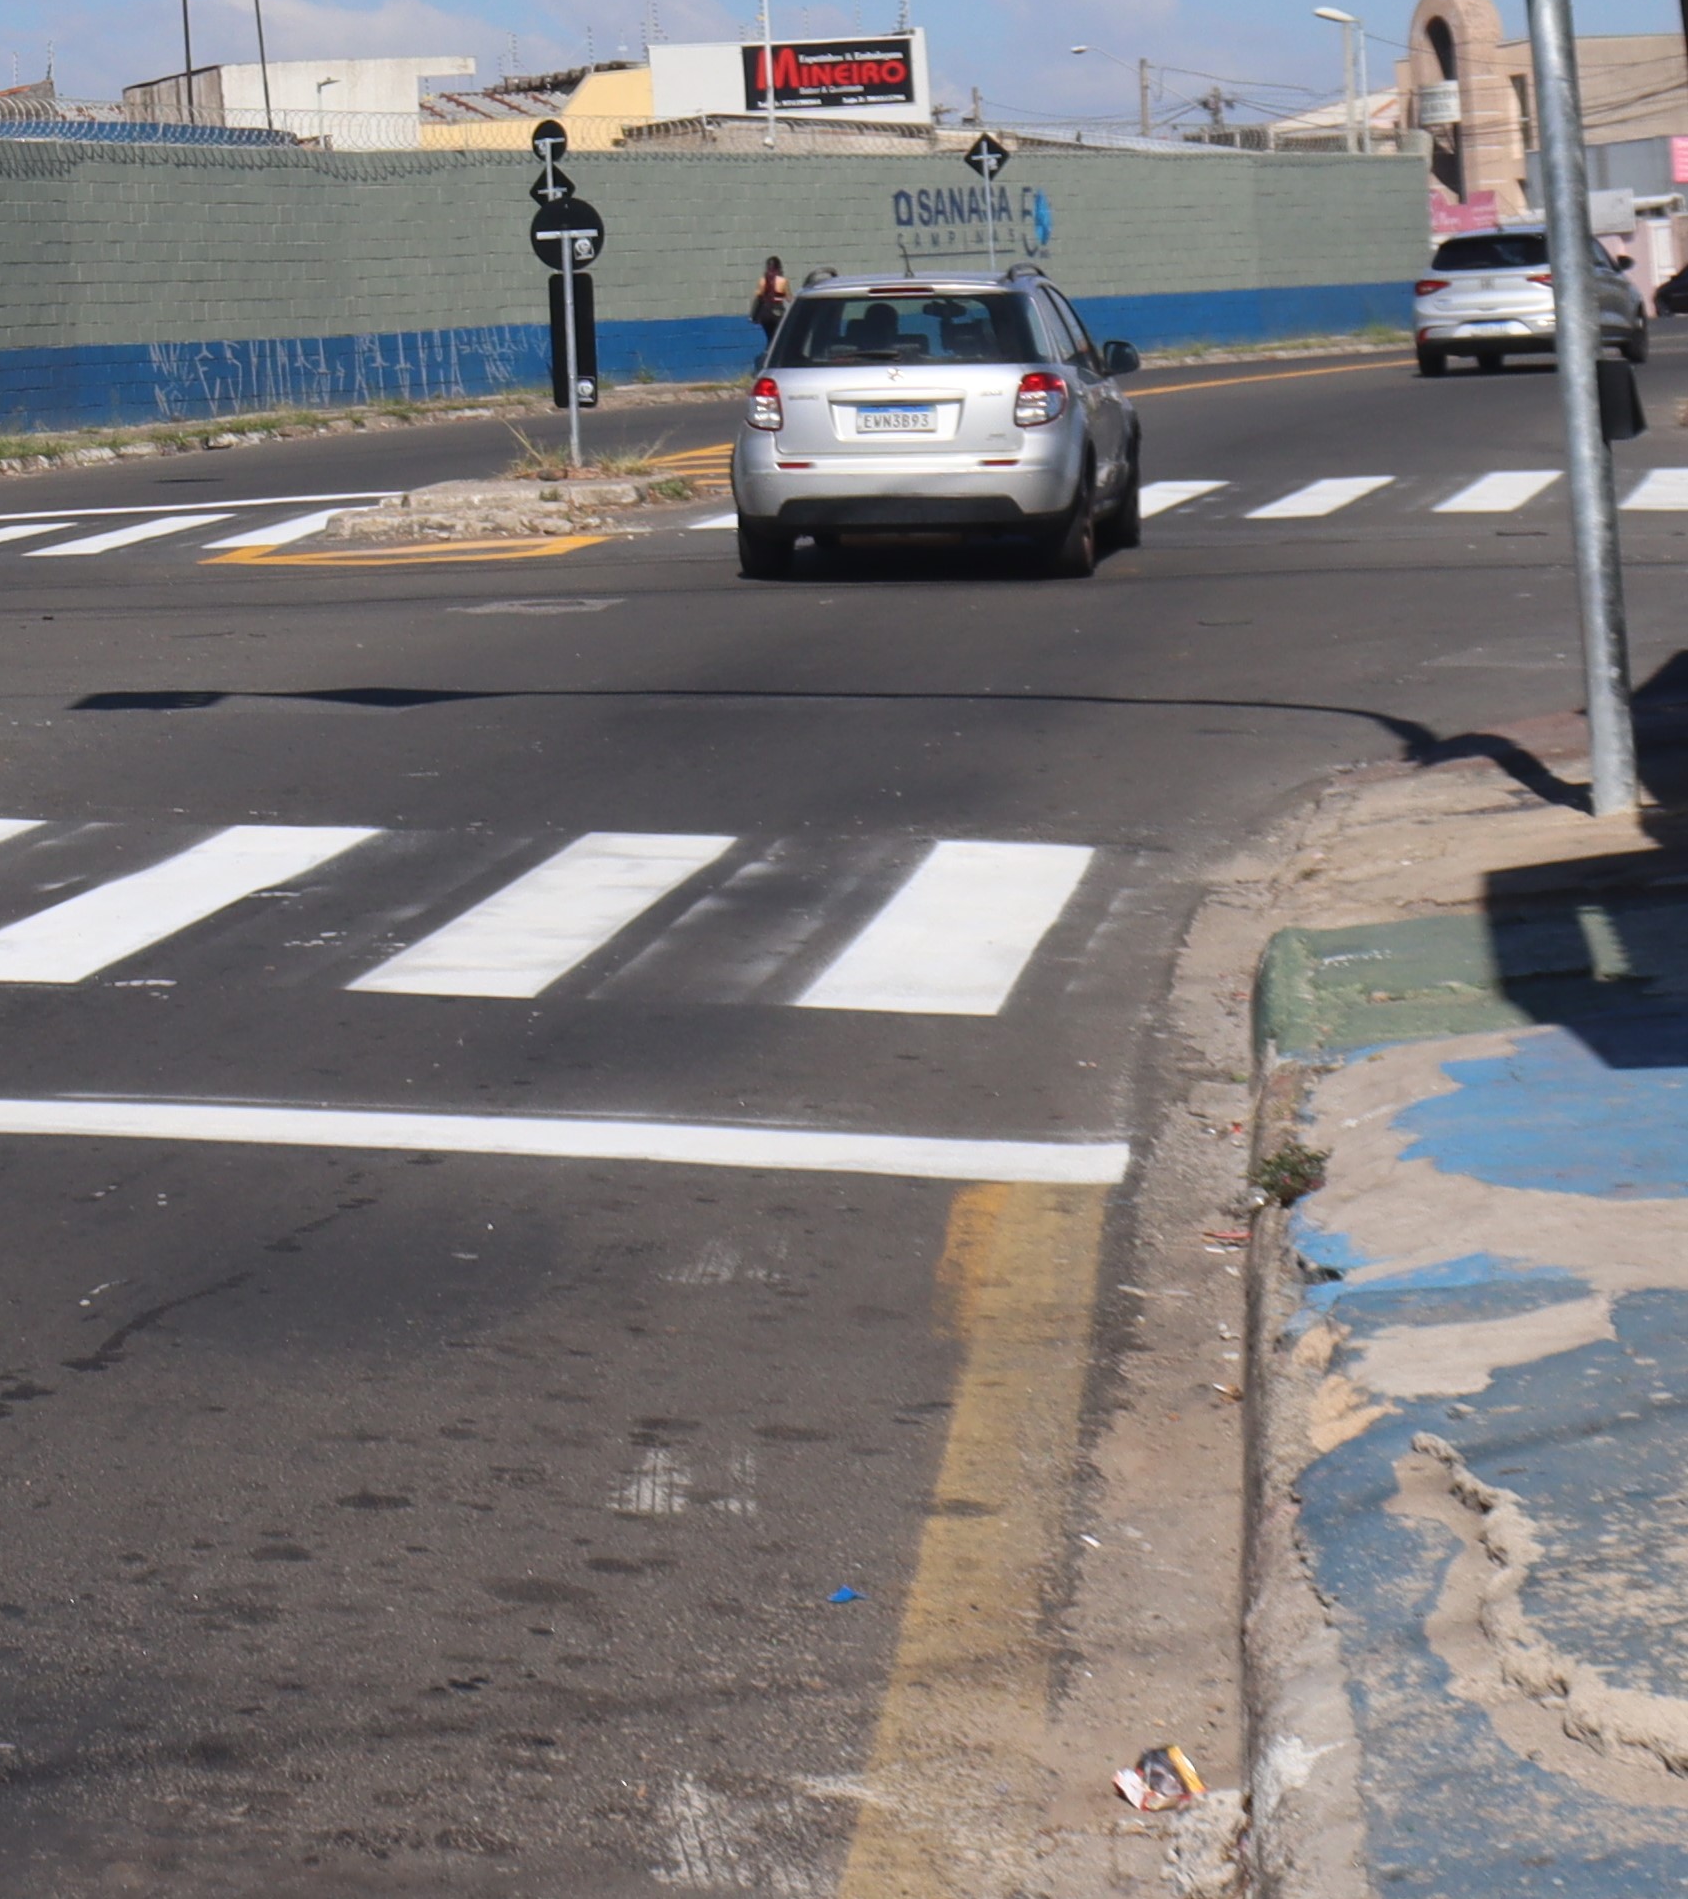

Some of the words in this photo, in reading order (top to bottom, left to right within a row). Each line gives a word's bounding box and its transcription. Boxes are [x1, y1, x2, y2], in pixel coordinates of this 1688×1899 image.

[917, 185, 1013, 227] SANASA
[896, 228, 1016, 249] CAMPINAS
[863, 412, 930, 429] EWN3B93
